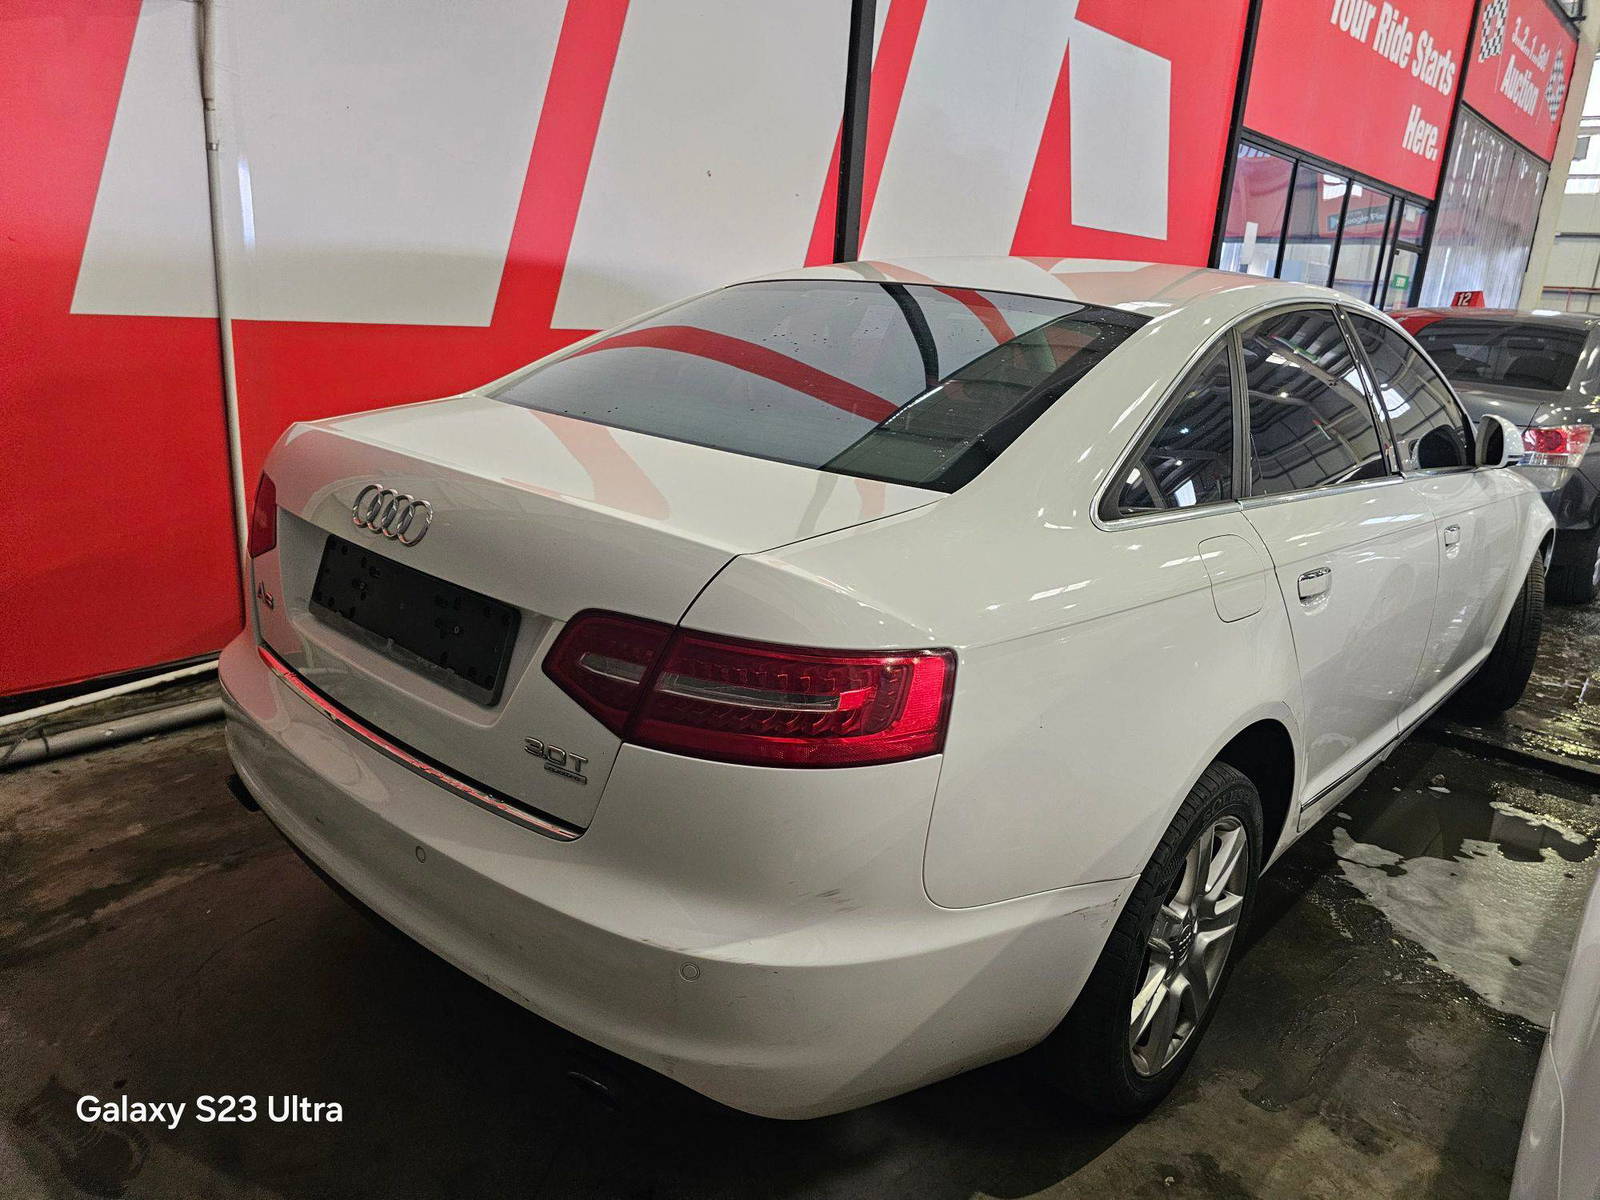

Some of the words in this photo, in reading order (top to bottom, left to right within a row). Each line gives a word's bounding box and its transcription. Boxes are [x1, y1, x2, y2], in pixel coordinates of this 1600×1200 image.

[1372, 1, 1414, 69] Ride
[1411, 30, 1456, 96] Starts
[1500, 54, 1539, 117] Auction
[1402, 104, 1439, 162] Here.
[1457, 292, 1472, 306] 12
